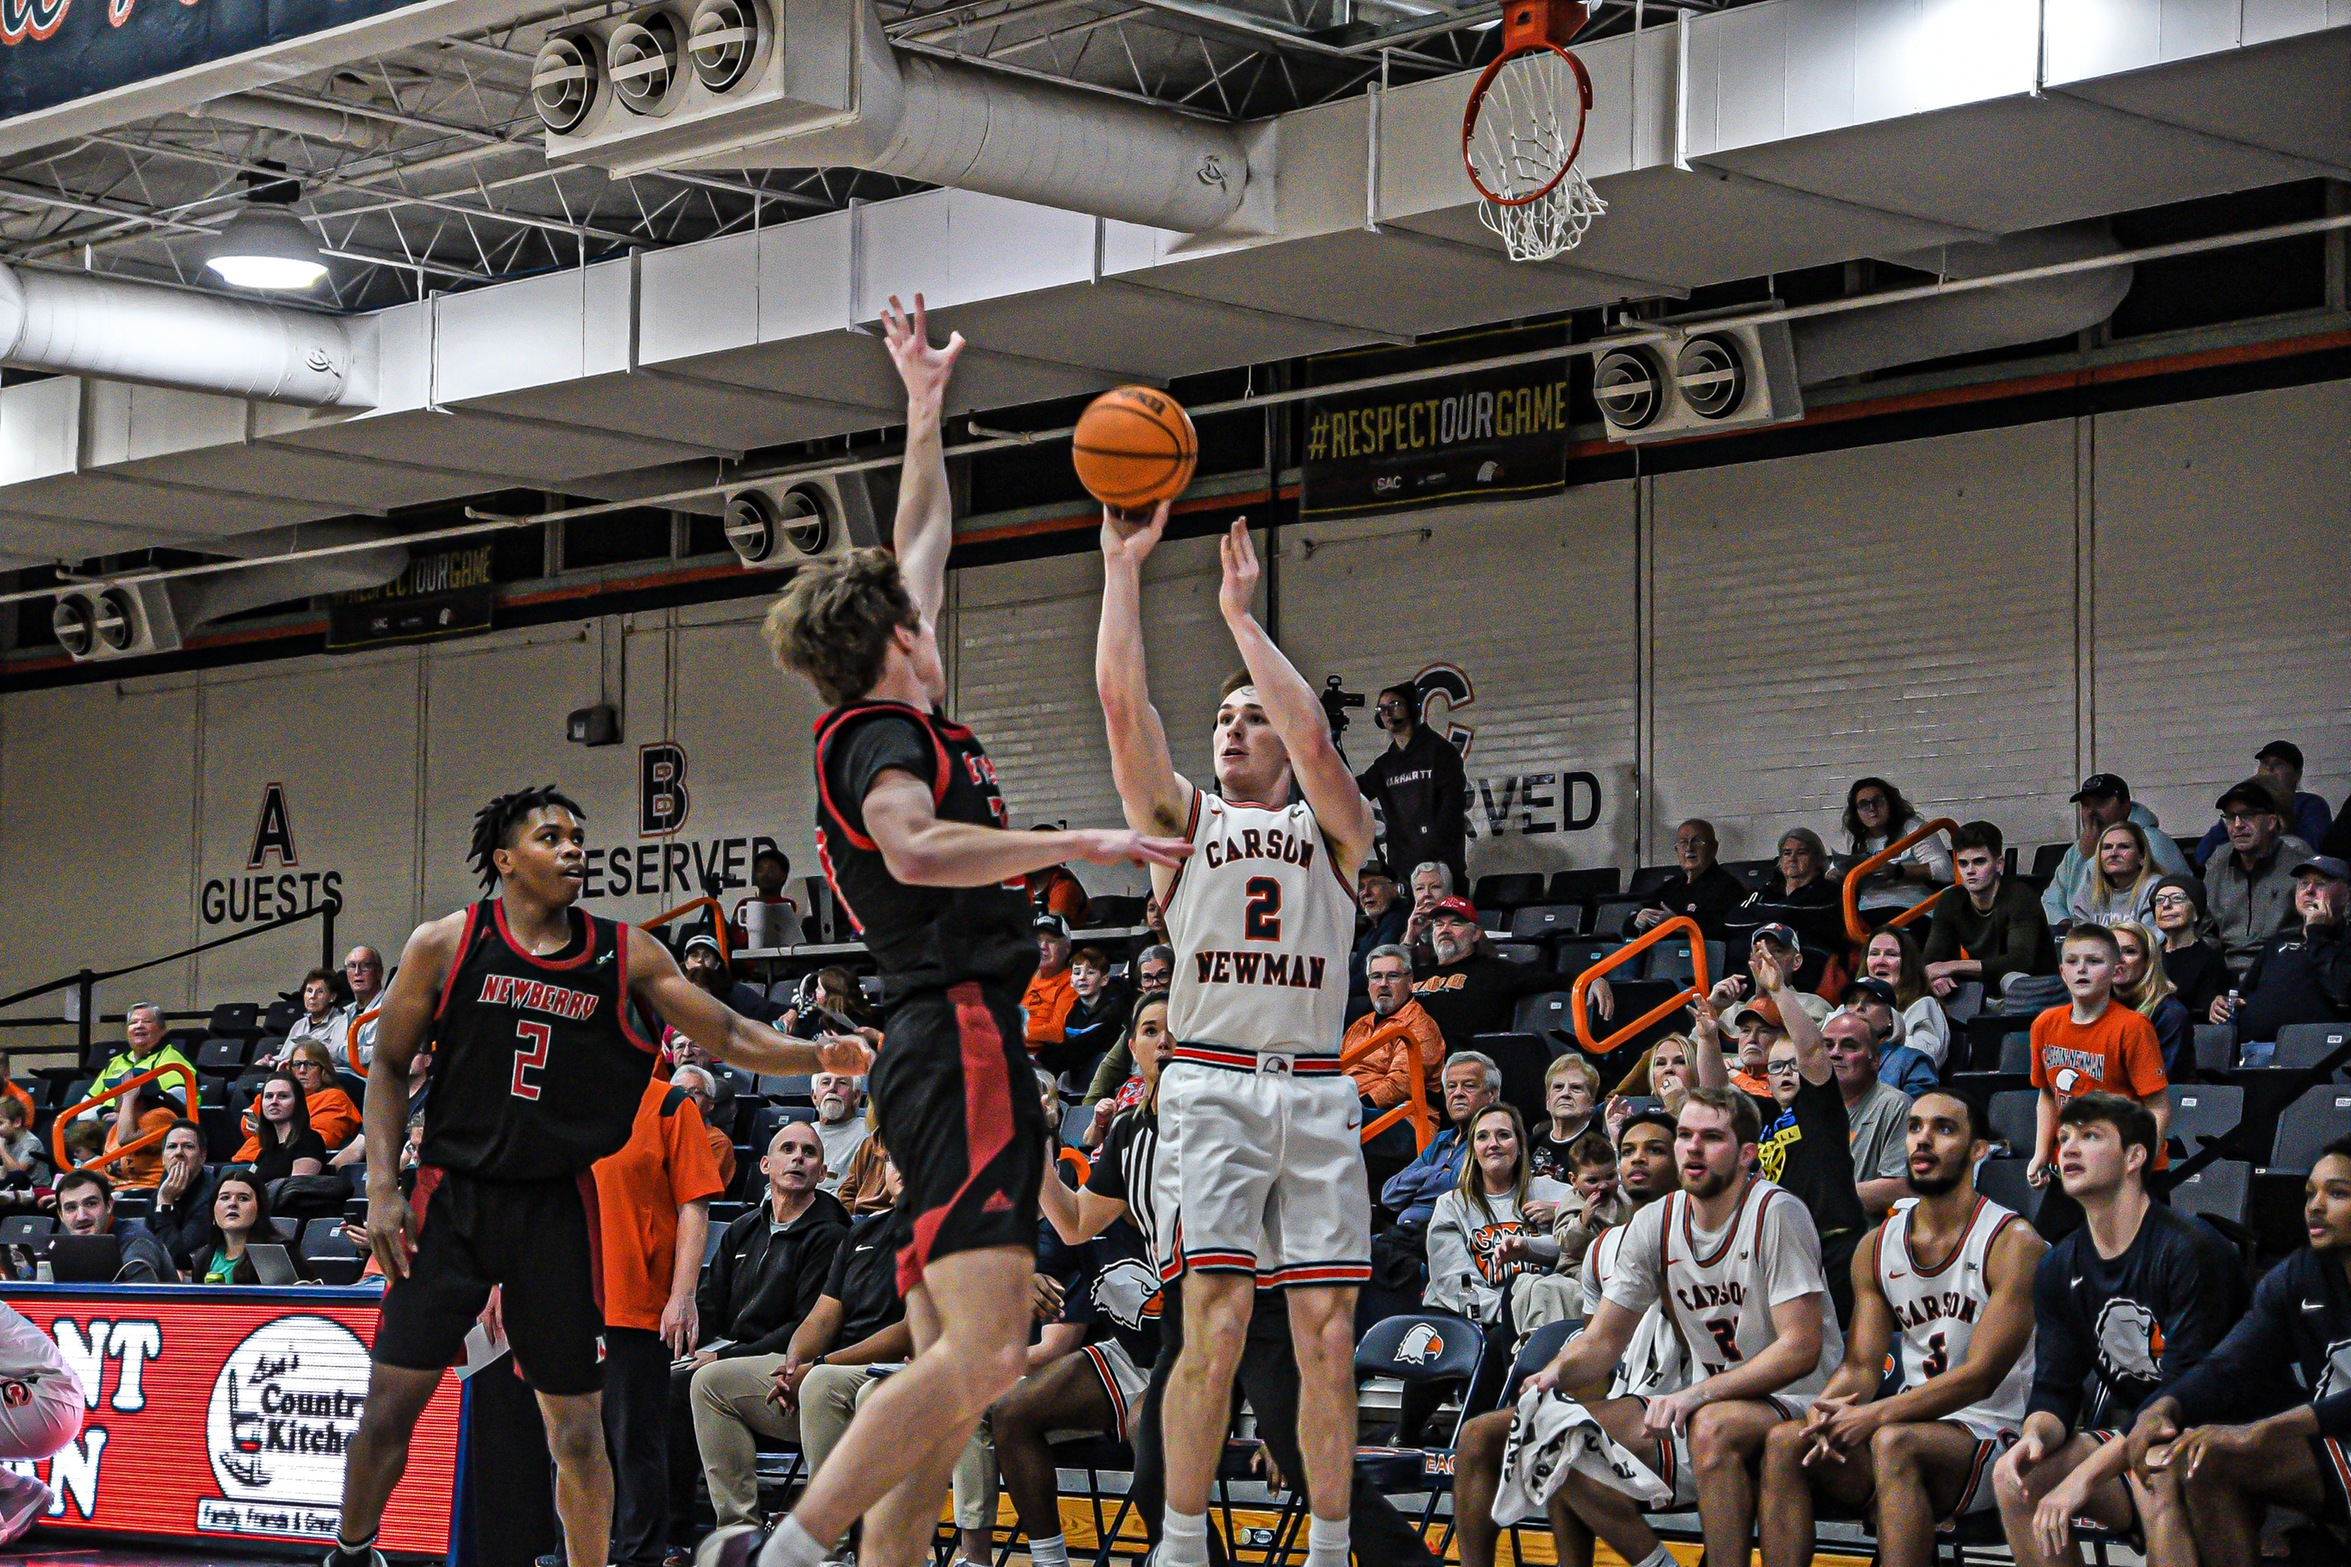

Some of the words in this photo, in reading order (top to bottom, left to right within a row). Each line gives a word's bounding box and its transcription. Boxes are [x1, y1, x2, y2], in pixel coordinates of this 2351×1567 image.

[1307, 381, 1567, 460] #RESPECTOURGAME
[1376, 476, 1401, 492] SAC
[639, 742, 690, 839] B
[247, 782, 298, 870] A
[1205, 828, 1315, 871] CARSON
[201, 870, 343, 925] GUESTS
[1244, 875, 1282, 942] 2
[477, 973, 600, 1021] NEWBERRY
[1195, 950, 1326, 990] NEWMAN
[510, 1019, 552, 1101] 2
[1895, 1291, 1977, 1329] CARSON
